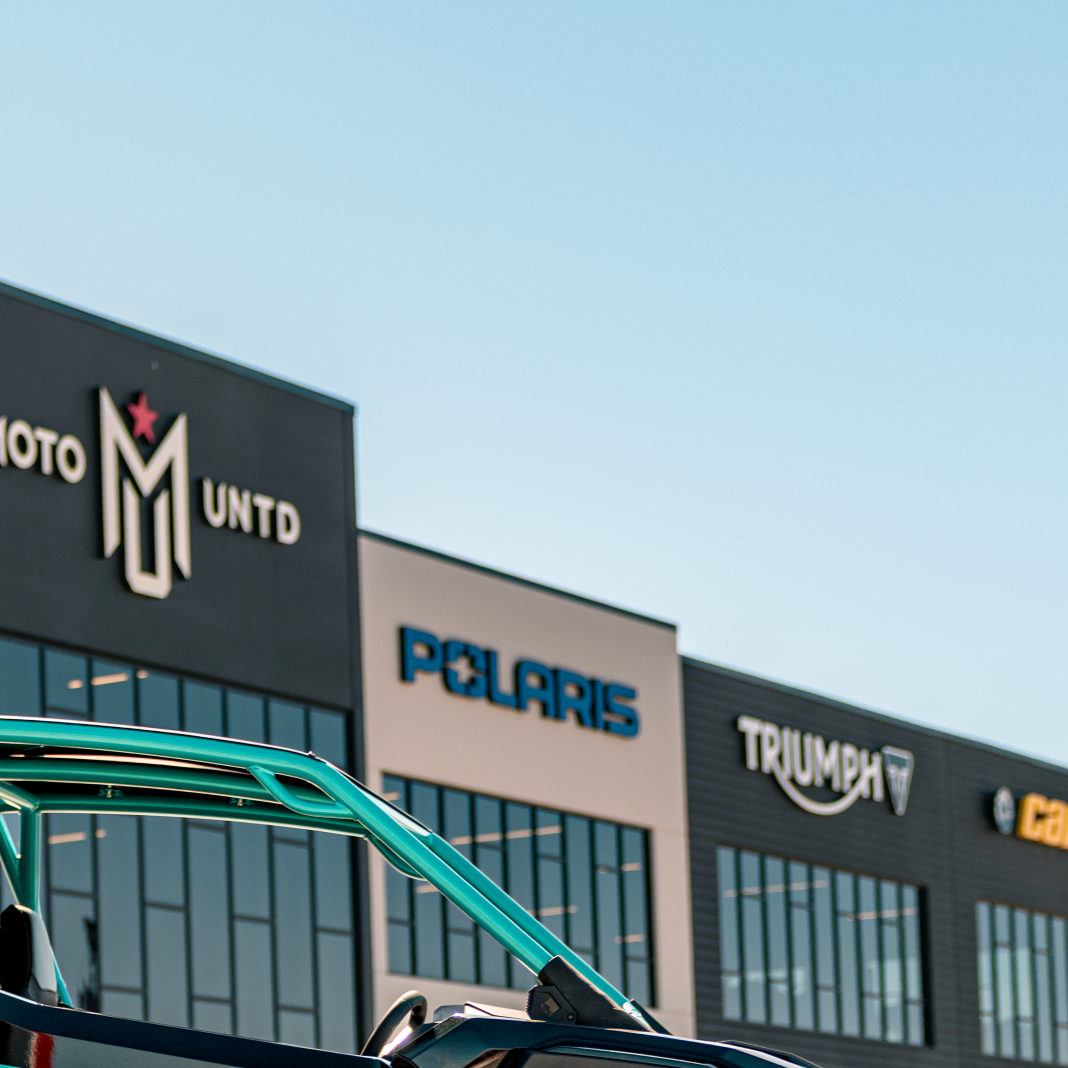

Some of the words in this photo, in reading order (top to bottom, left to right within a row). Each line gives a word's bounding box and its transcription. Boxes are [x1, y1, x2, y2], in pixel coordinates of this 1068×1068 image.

[202, 476, 302, 546] UNTD
[398, 624, 641, 739] POLARIS
[737, 713, 883, 816] TRIUMPH
